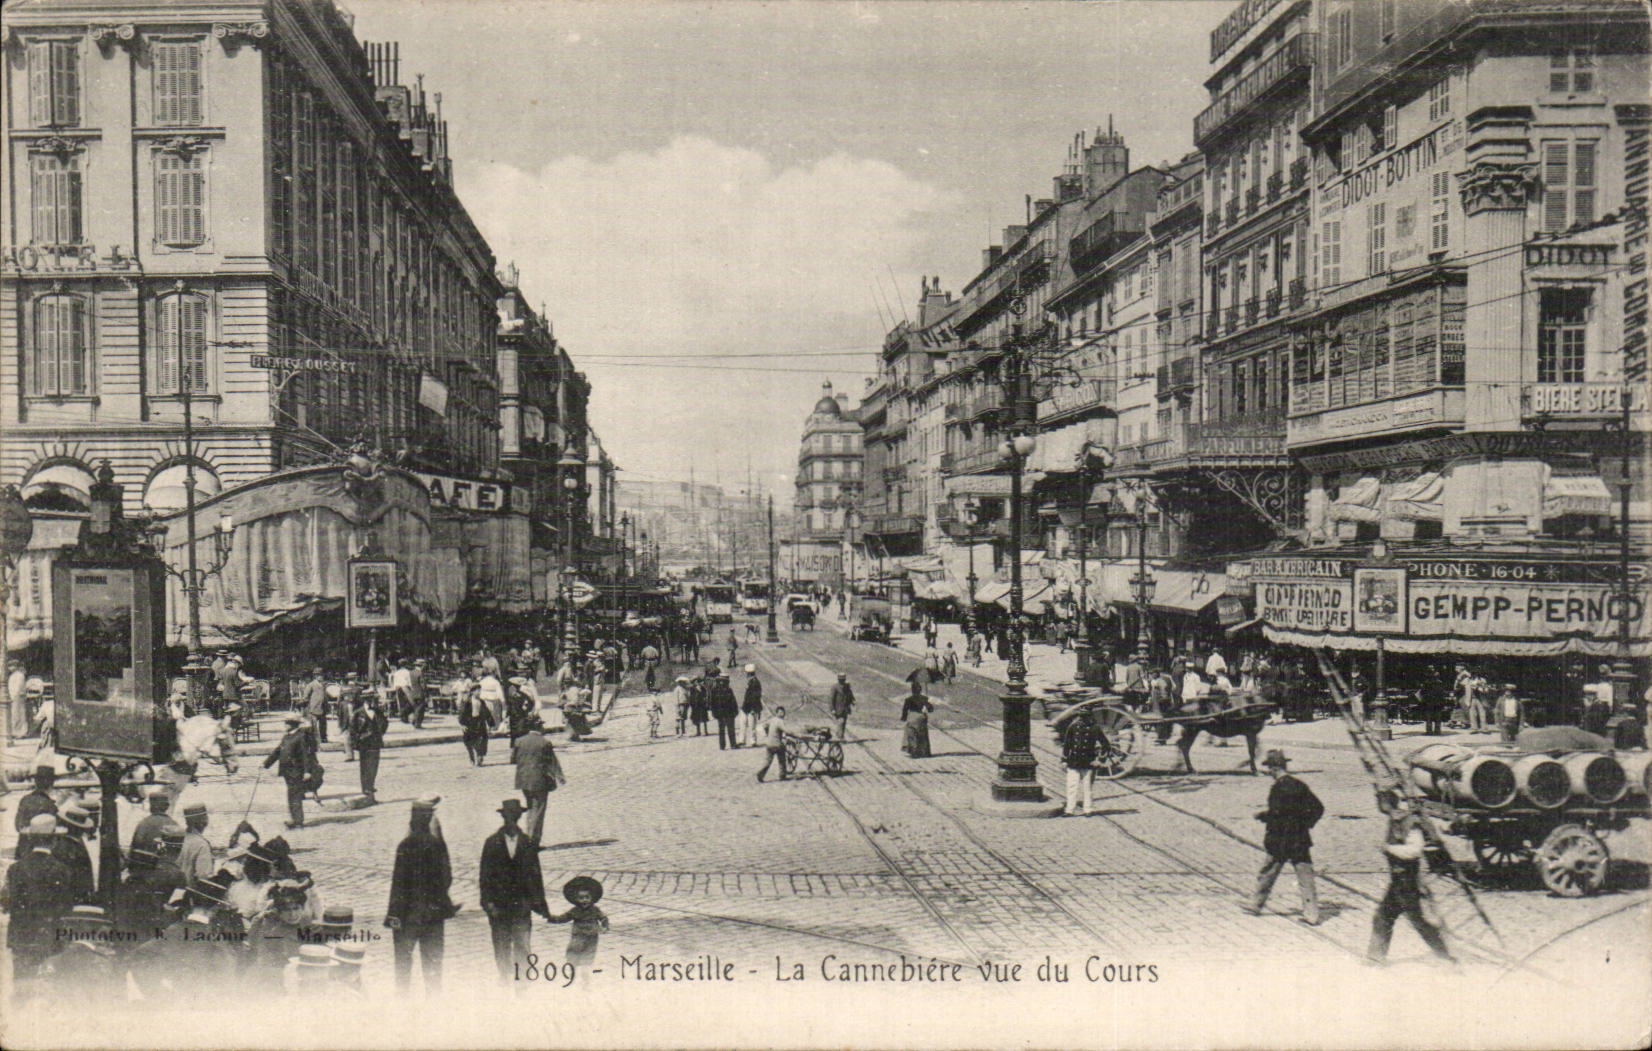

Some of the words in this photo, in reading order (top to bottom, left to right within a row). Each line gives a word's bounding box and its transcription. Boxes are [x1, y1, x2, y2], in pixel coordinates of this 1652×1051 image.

[1526, 246, 1609, 267] DIDOT
[429, 478, 498, 509] AFE
[1491, 565, 1537, 579] 16-04
